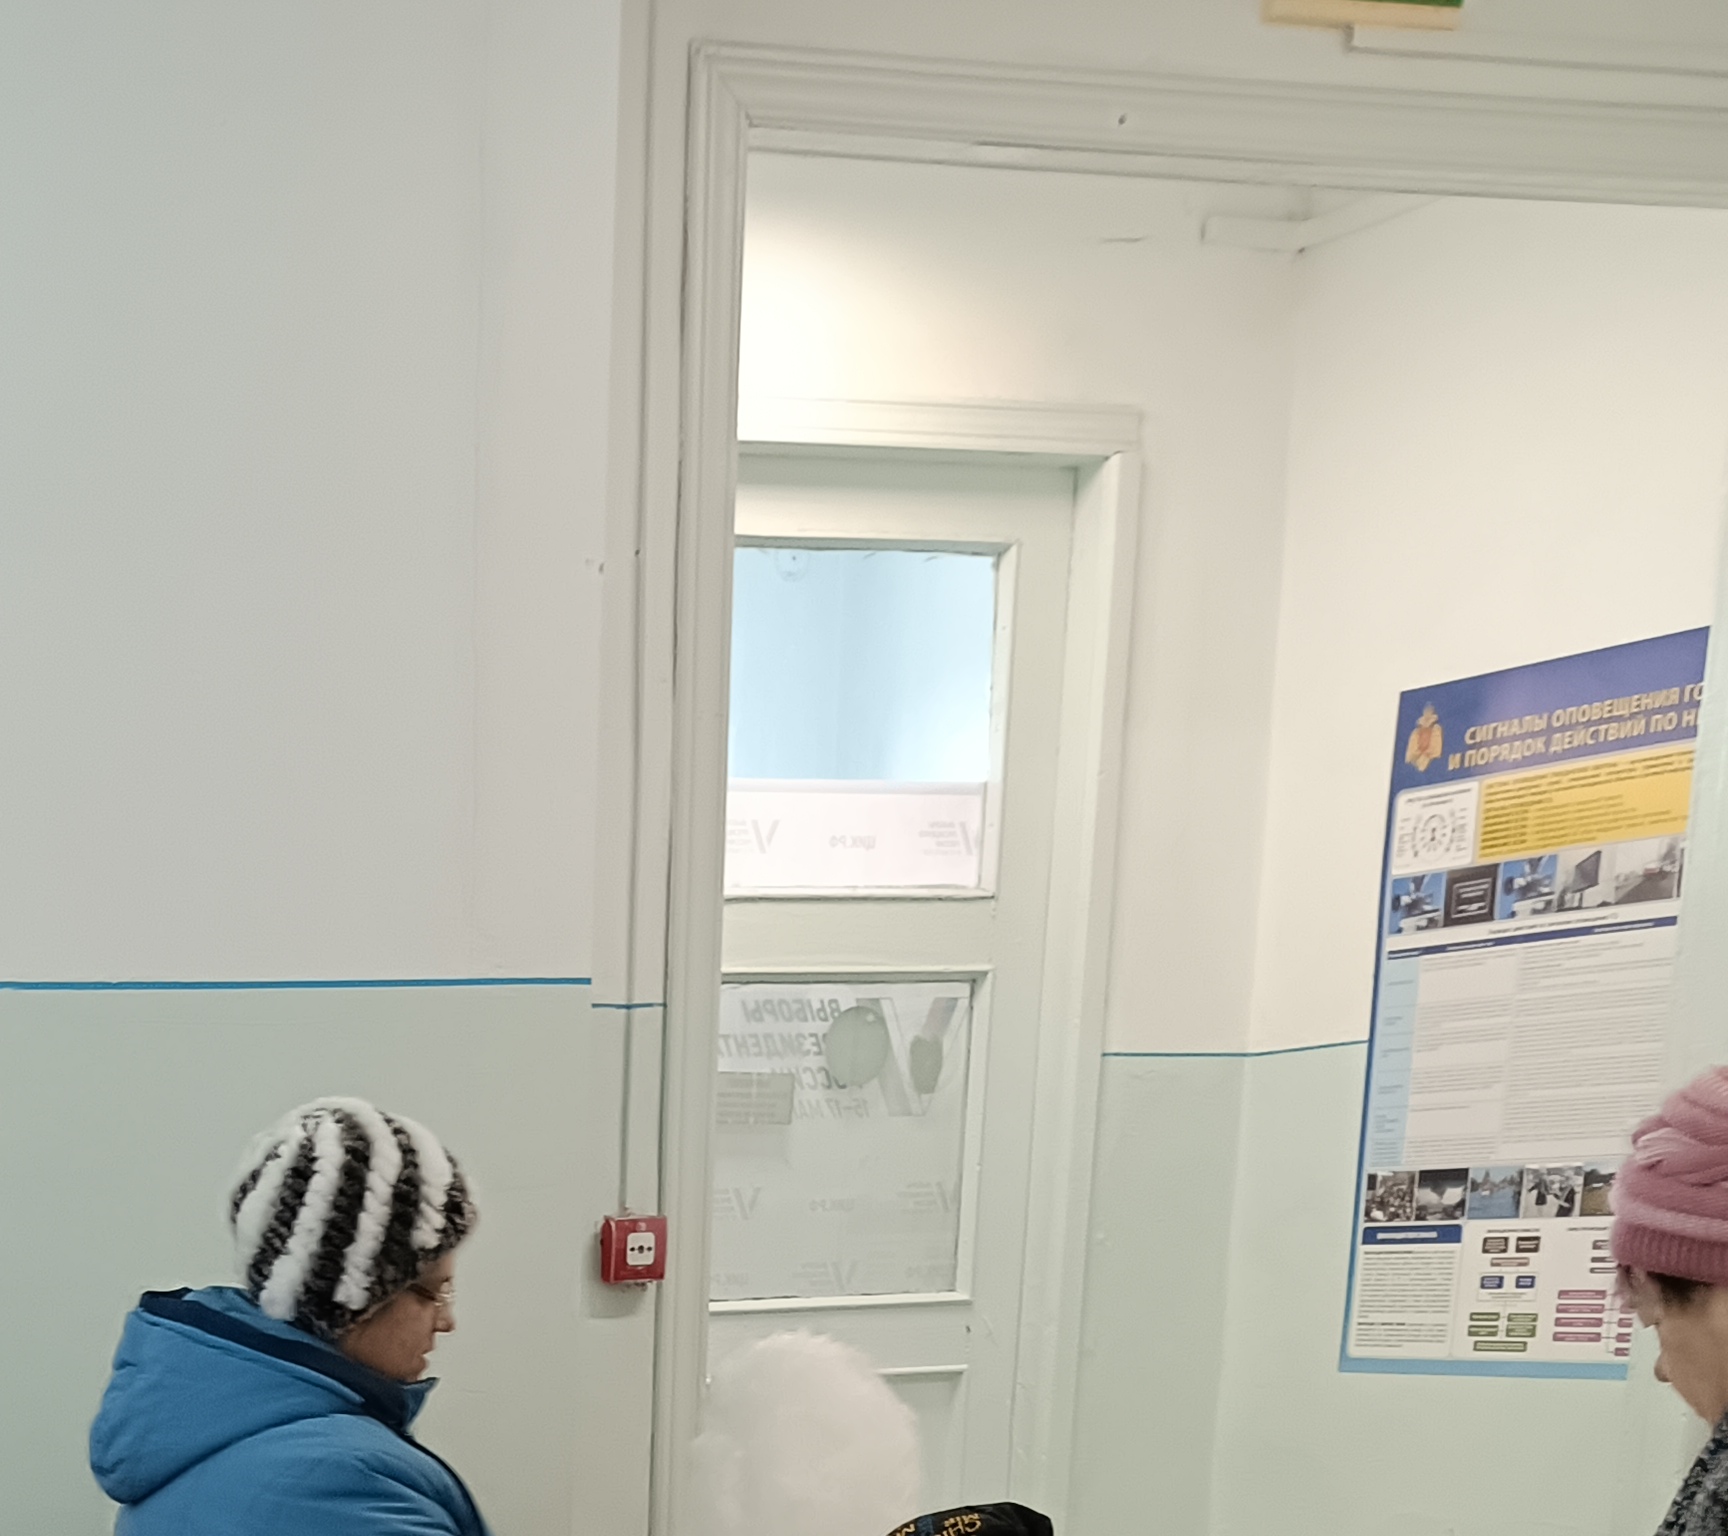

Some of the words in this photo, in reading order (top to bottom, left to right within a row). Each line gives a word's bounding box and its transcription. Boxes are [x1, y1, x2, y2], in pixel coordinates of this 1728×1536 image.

[1448, 753, 1462, 771] И
[1464, 736, 1547, 768] ПОРЯДОК
[1549, 716, 1646, 755] ДЕЙСТВИЙ
[1650, 711, 1678, 733] ПО
[1681, 707, 1699, 728] Н
[1464, 712, 1549, 745] СИГНАЛЫ
[1552, 687, 1680, 728] ОПОВЕЩЕНИЯ
